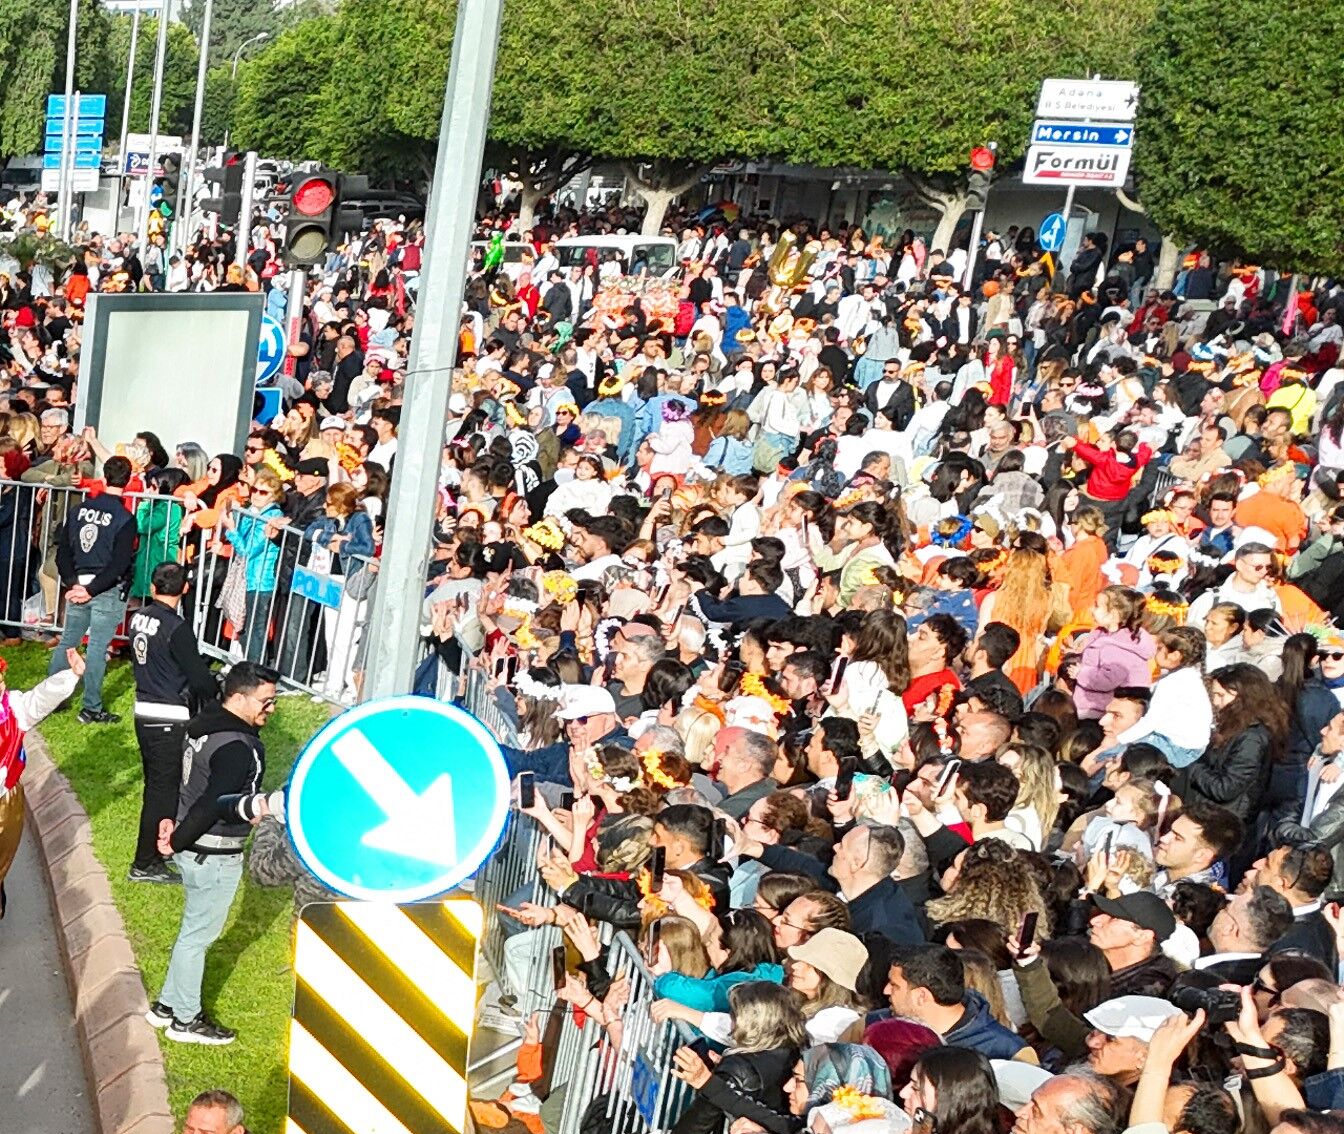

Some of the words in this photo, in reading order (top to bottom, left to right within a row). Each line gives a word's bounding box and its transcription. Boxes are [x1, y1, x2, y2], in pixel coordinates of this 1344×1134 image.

[1058, 88, 1103, 98] Adana
[1038, 127, 1100, 142] Mersin
[1032, 151, 1120, 173] Formül
